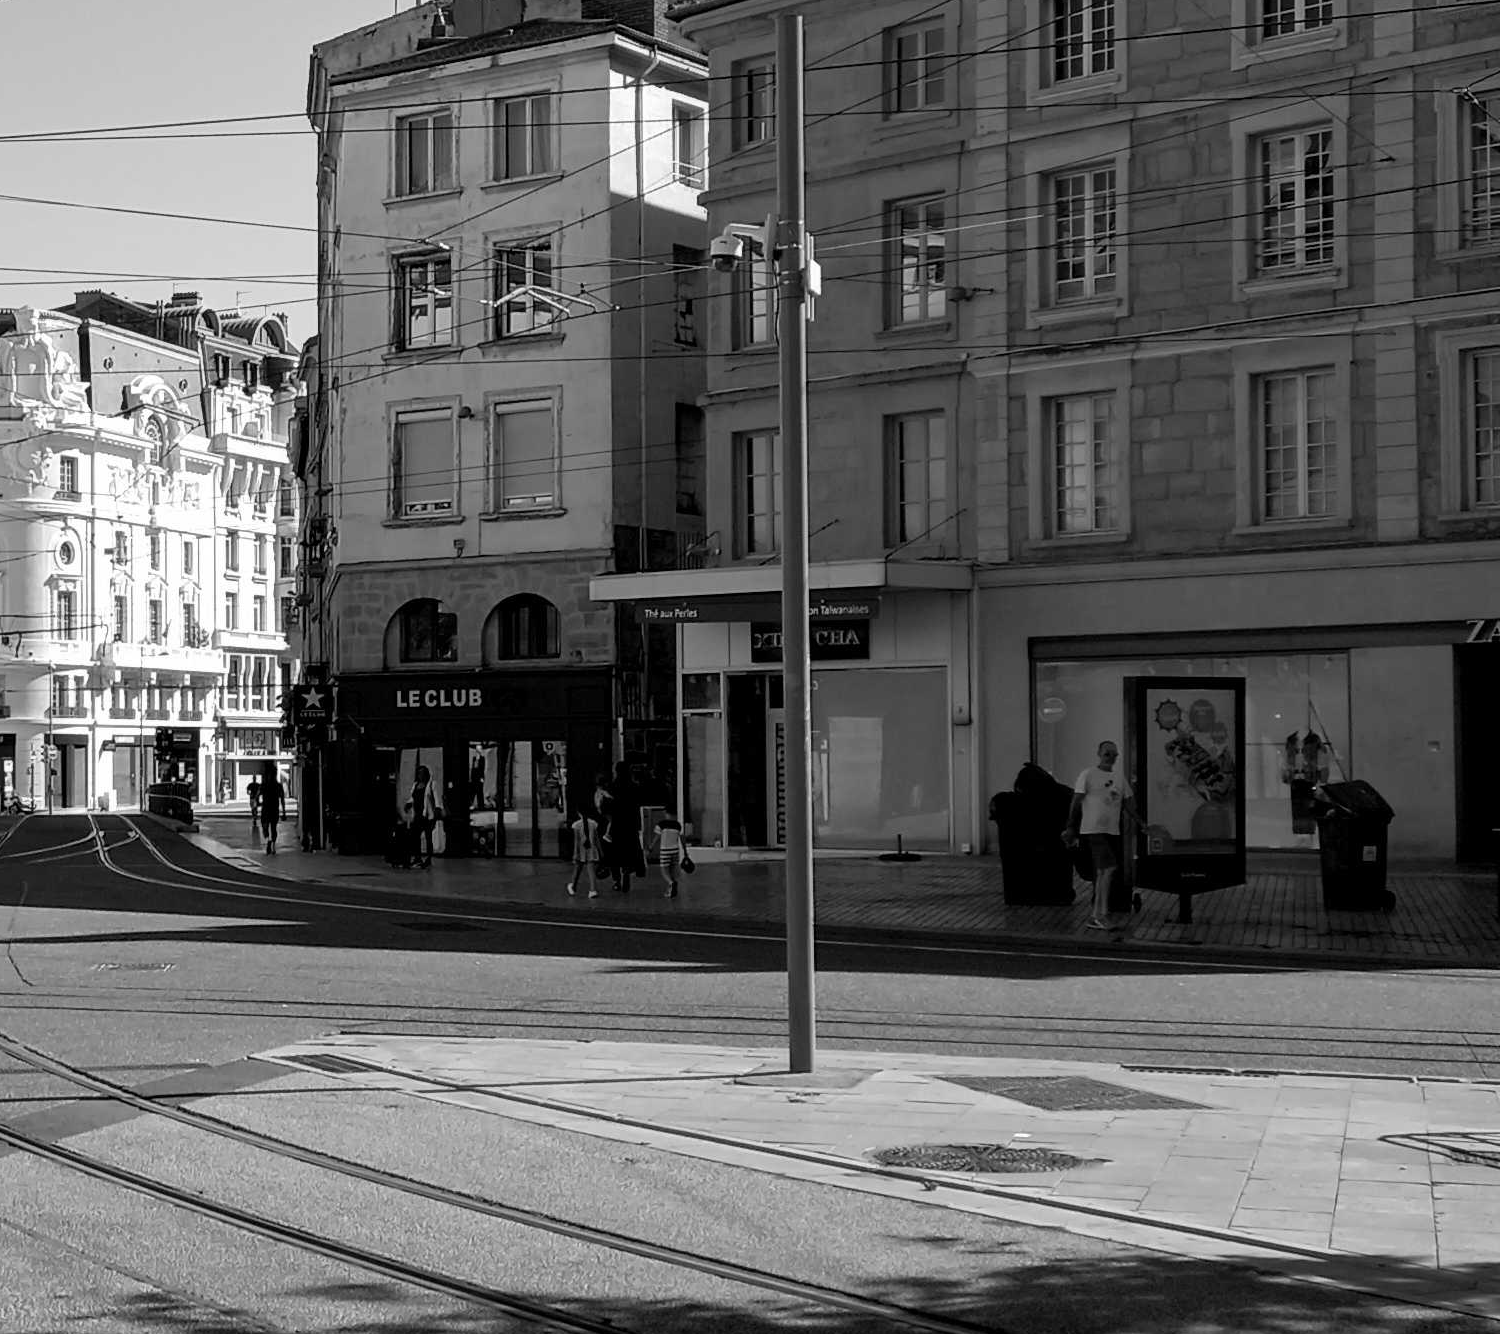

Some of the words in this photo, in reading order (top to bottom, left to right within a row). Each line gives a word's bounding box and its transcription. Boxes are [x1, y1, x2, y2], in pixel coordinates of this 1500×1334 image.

[815, 629, 860, 646] CHA
[396, 689, 421, 708] LE
[424, 688, 482, 708] CLUB
